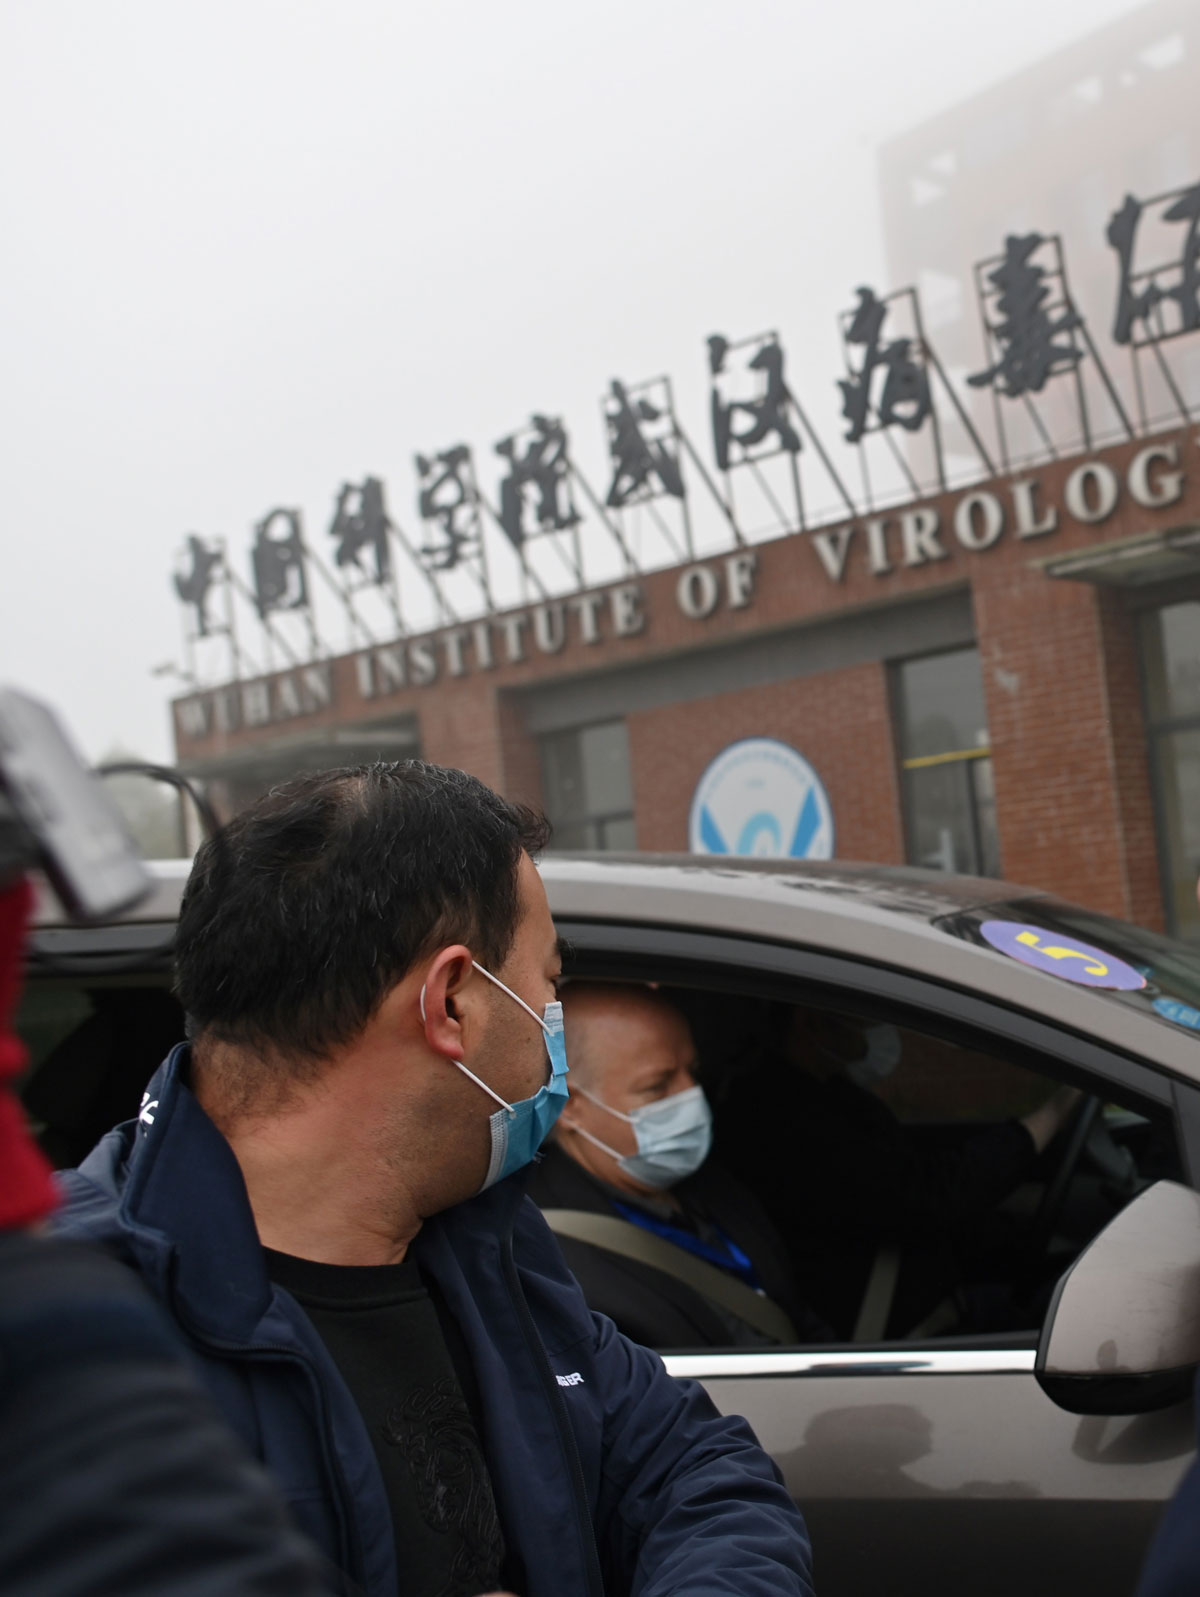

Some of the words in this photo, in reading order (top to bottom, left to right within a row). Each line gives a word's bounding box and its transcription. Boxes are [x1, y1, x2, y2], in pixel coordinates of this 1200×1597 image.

[354, 585, 645, 698] INSTITUTE
[676, 553, 757, 618] OF
[1015, 931, 1109, 977] 5
